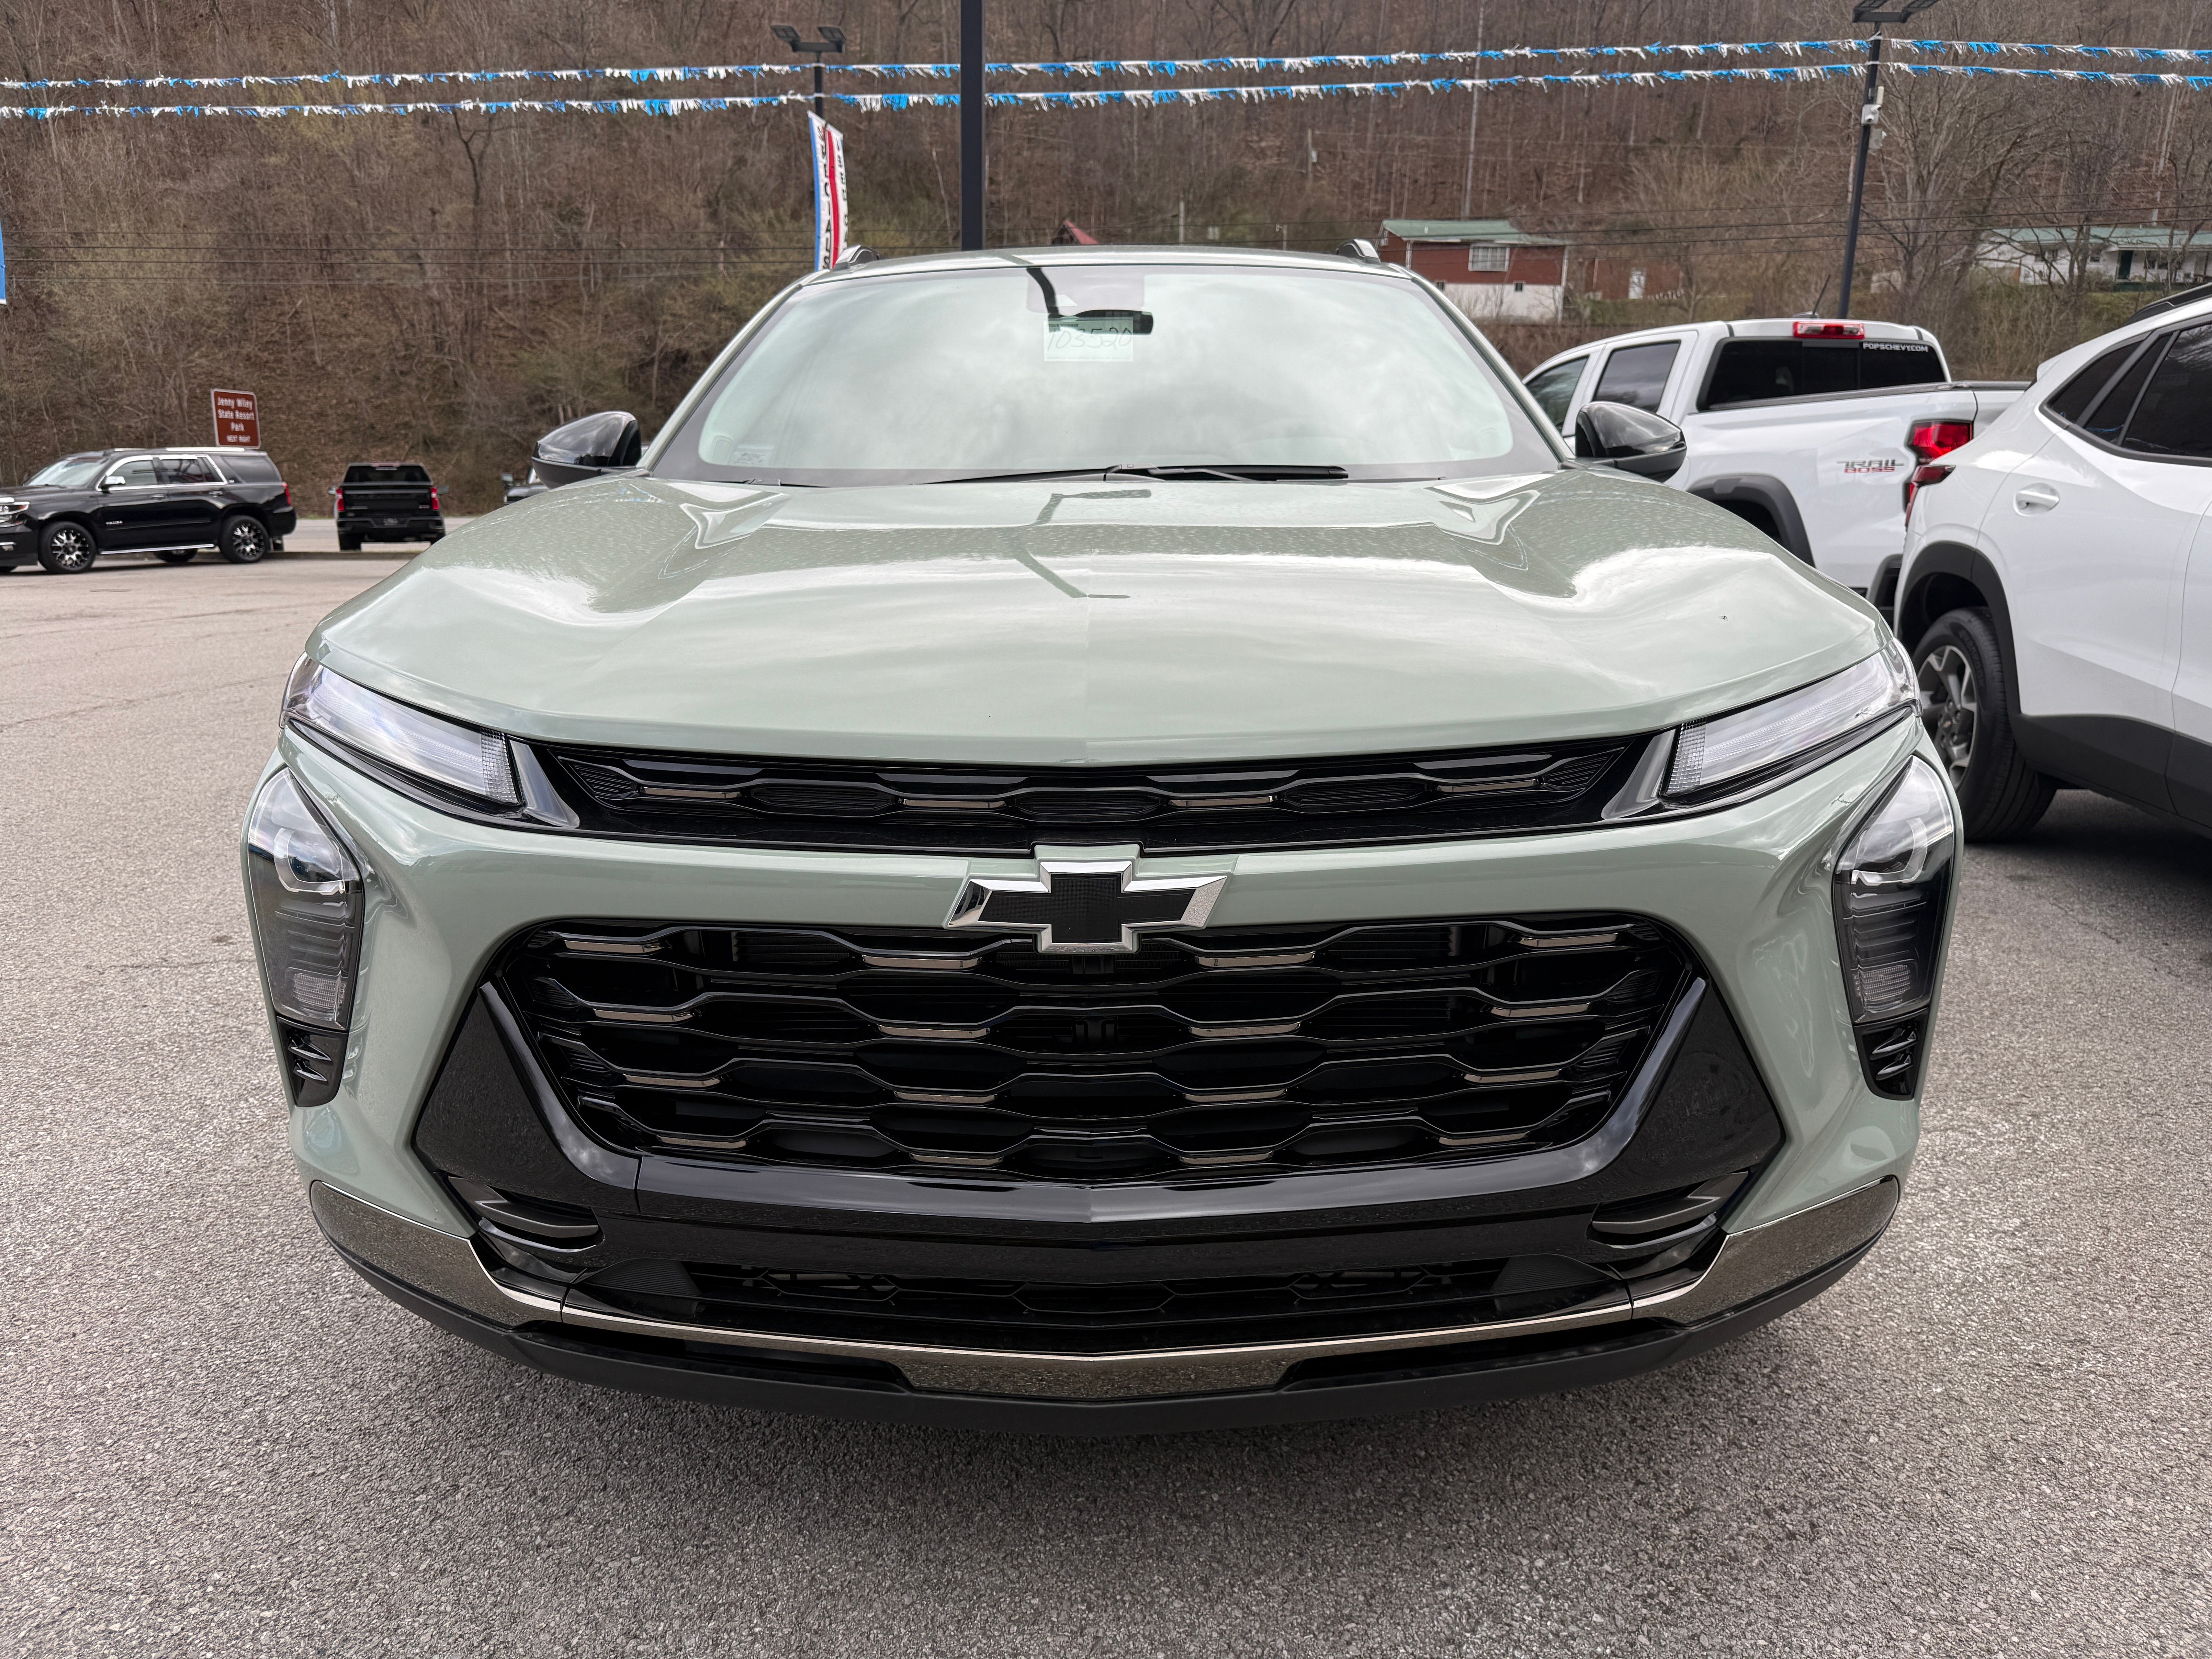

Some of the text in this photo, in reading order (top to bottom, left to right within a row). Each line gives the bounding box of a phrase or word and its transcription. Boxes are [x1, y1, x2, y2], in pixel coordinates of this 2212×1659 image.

[1047, 327, 1132, 351] 103520
[217, 396, 253, 410] Jenny Wiley
[218, 409, 255, 420] State Resort
[230, 421, 245, 432] Park
[1836, 459, 1904, 468] TRAIL
